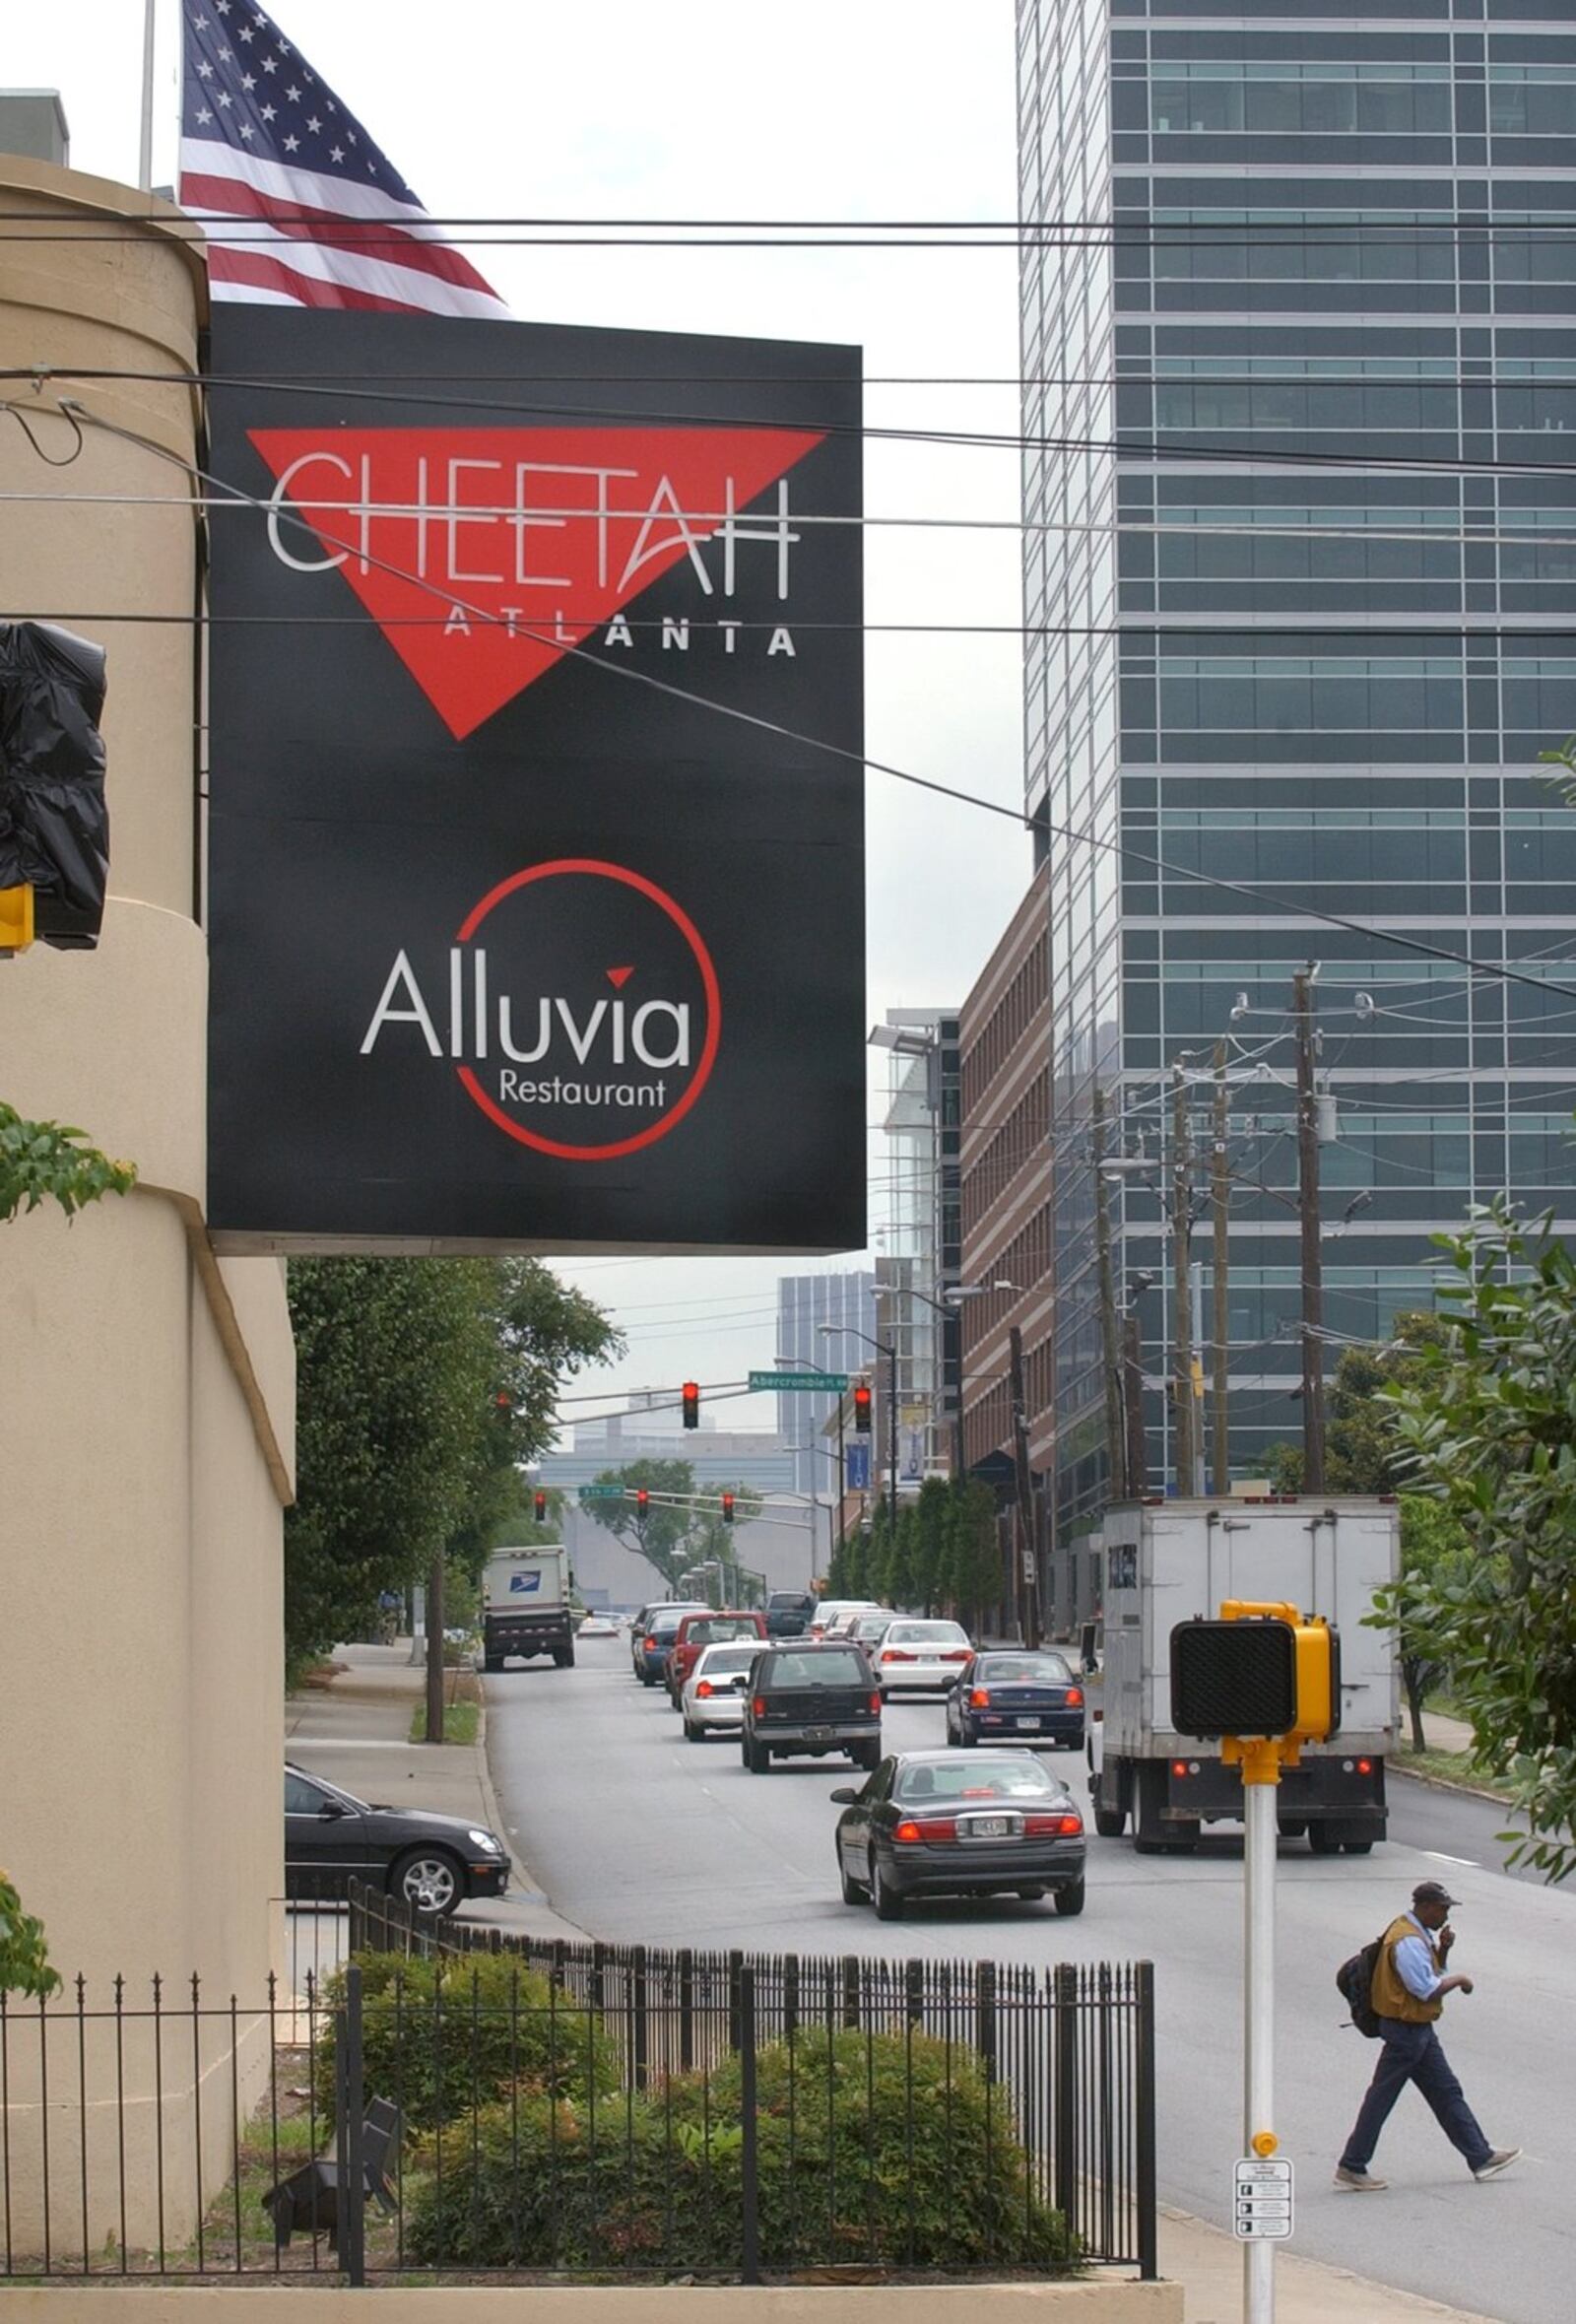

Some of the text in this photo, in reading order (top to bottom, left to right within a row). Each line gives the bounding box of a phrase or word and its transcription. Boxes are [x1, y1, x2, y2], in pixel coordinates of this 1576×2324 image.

[267, 451, 801, 599] CHEETAH
[443, 606, 796, 657] ATLANTA
[360, 947, 690, 1069] Alluvia
[499, 1069, 666, 1106] Restaurant
